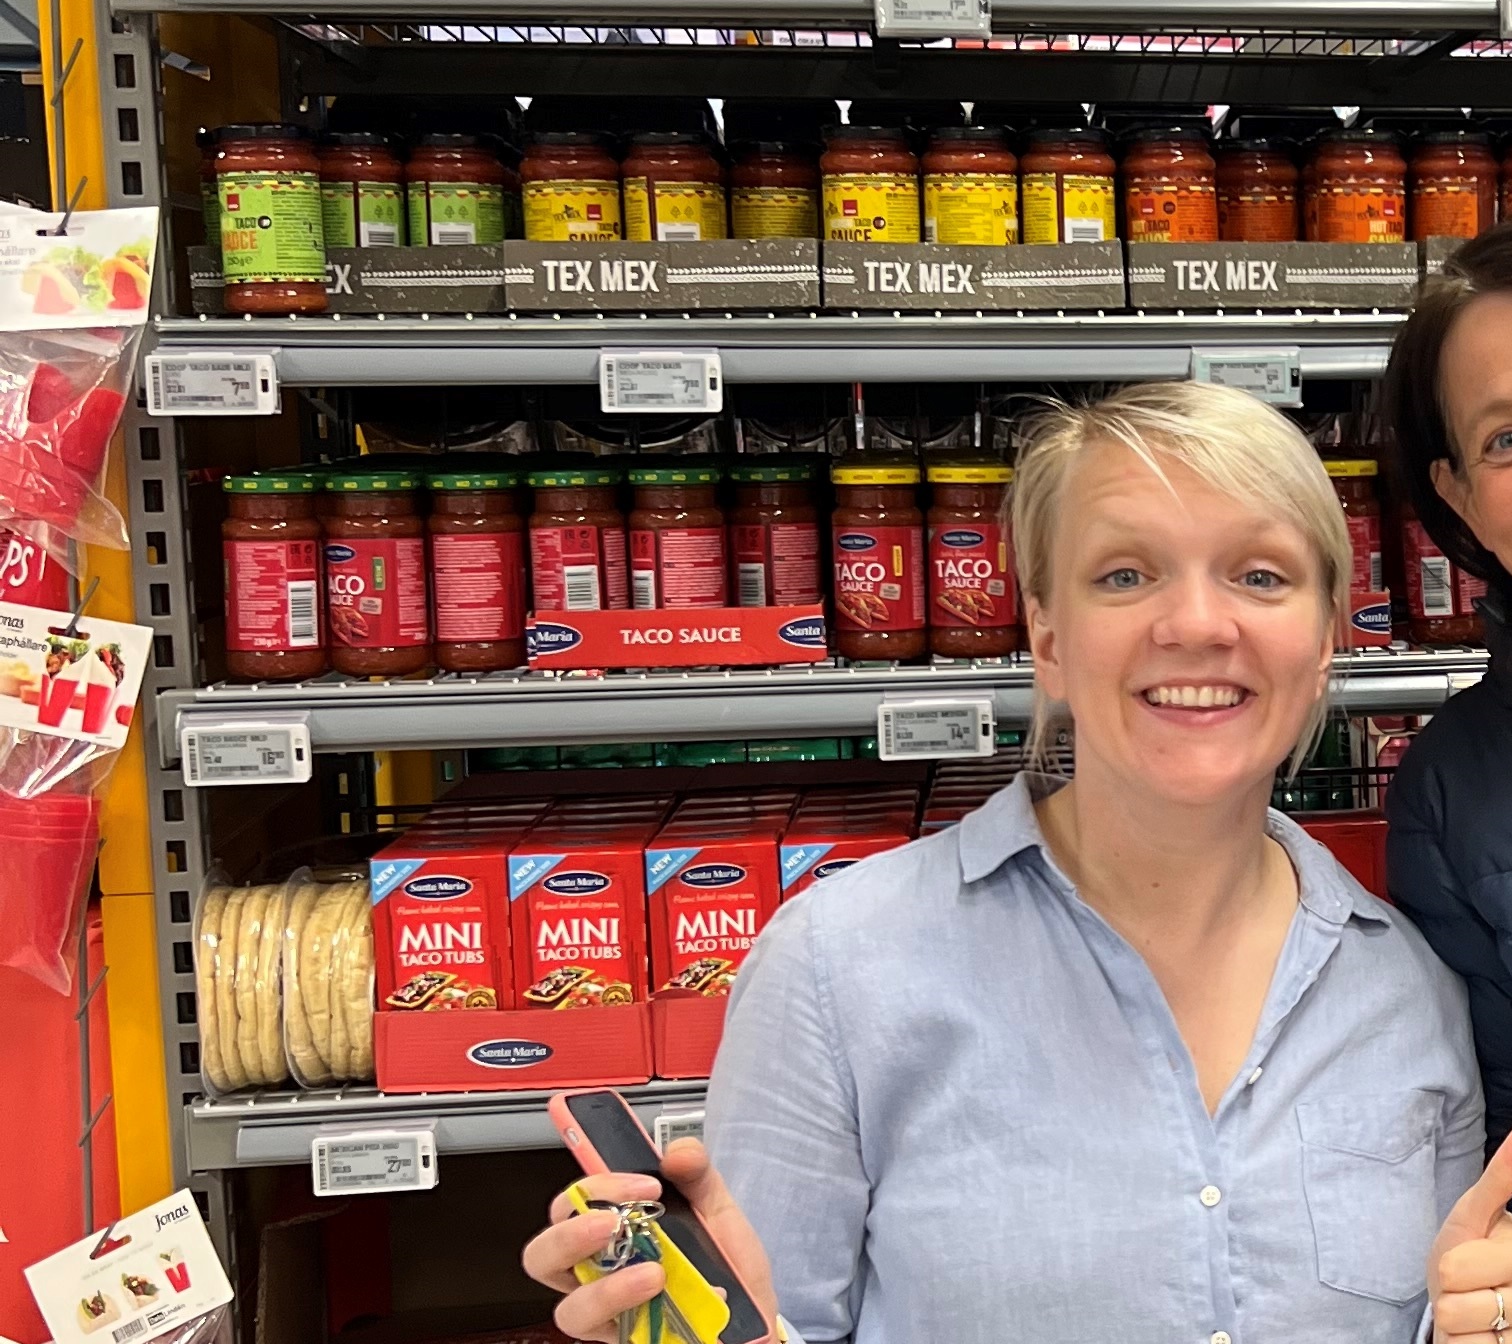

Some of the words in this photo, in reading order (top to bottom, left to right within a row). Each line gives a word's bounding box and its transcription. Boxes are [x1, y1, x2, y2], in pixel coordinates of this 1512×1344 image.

[1174, 261, 1217, 291] TEX
[1226, 261, 1280, 291] MEX
[835, 563, 886, 582] TACO
[935, 559, 992, 578] TACO
[841, 581, 874, 592] SAUCE
[944, 578, 981, 589] SAUCE
[1358, 613, 1389, 623] Santa
[535, 630, 573, 643] Maria
[620, 628, 673, 644] TACO
[679, 626, 742, 642] SAUCE
[785, 625, 821, 637] Santa
[651, 856, 673, 876] NEW
[537, 917, 621, 947] MINI
[675, 911, 759, 941] MINI
[400, 921, 482, 951] MINI
[537, 947, 578, 961] TACO
[582, 946, 622, 960] TUBS
[675, 940, 715, 954] TACO
[719, 938, 758, 953] TUBS
[400, 951, 440, 966] TACO
[443, 950, 485, 964] TUBS
